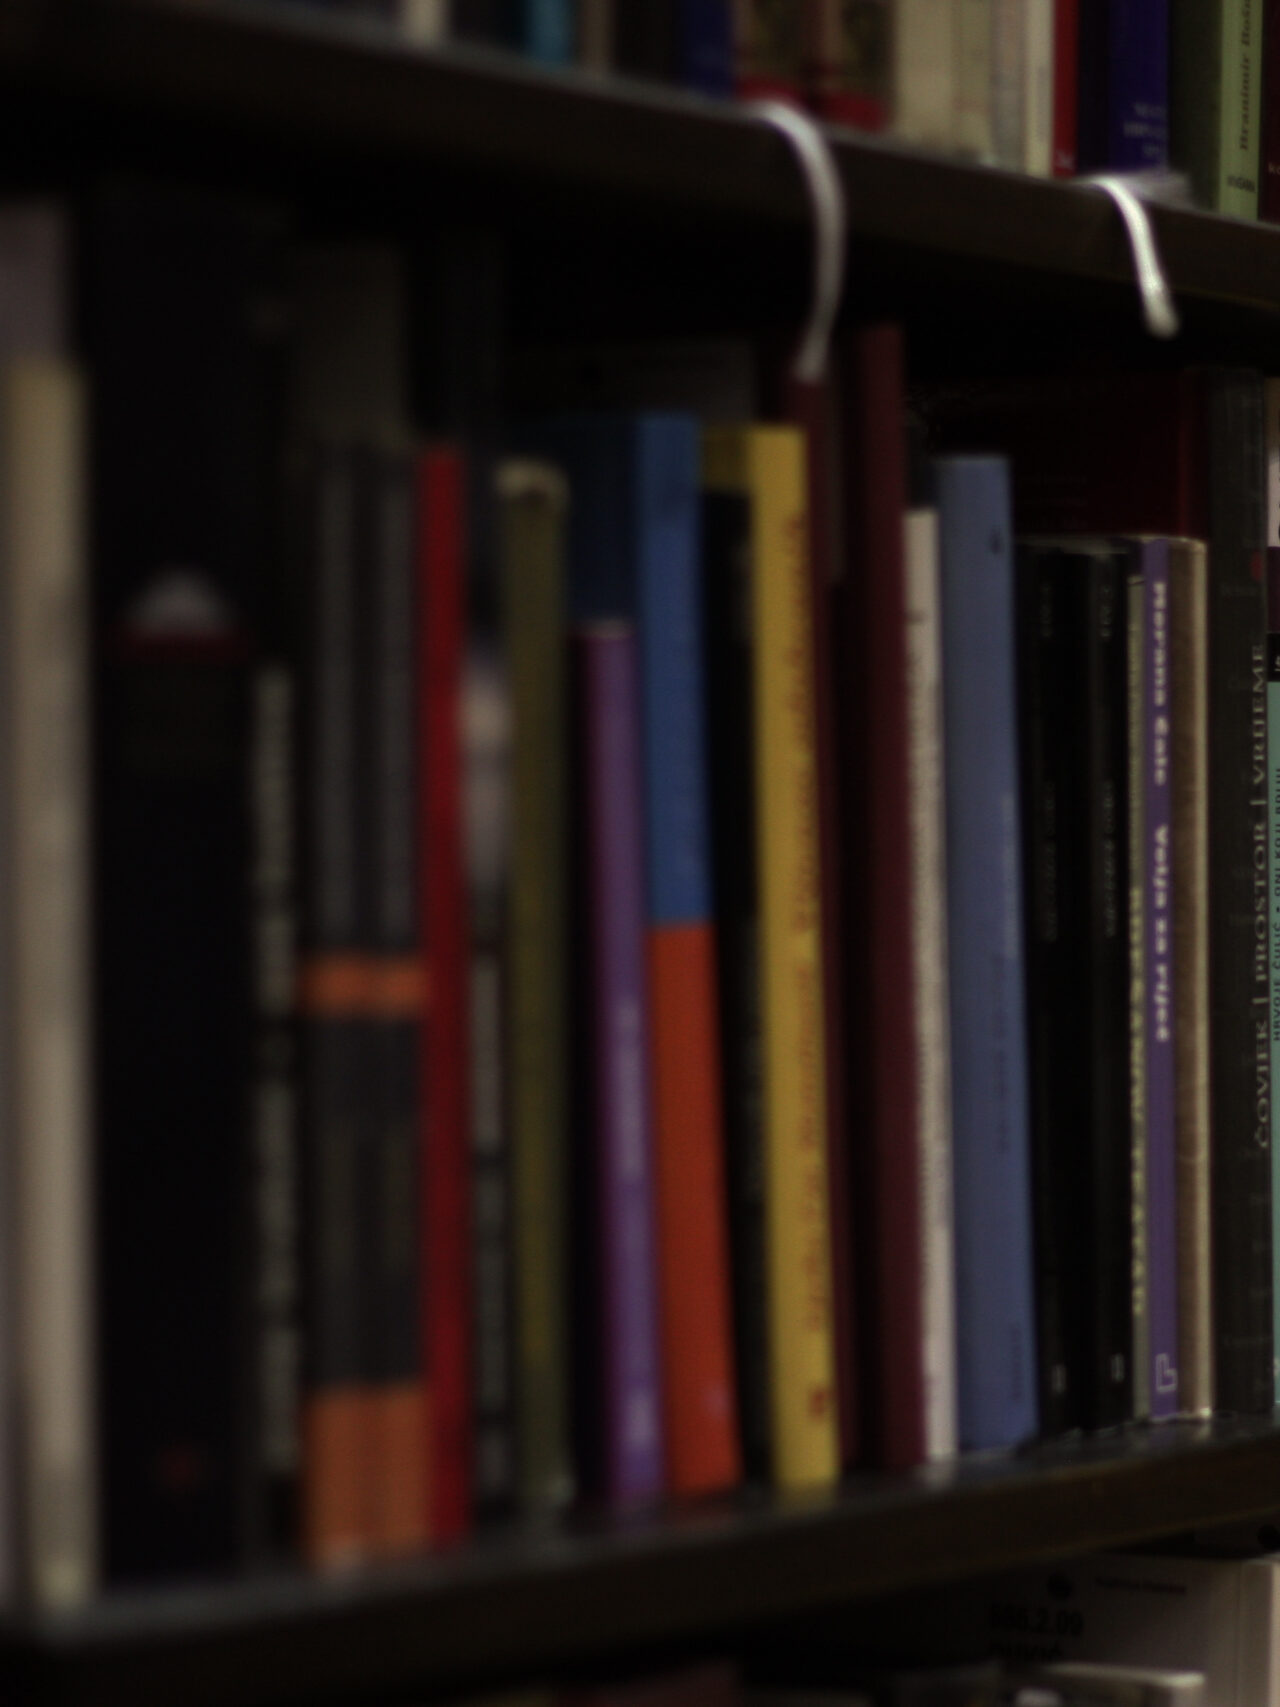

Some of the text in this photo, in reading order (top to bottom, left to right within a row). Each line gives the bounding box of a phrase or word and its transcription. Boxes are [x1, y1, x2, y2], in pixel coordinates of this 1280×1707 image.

[1252, 644, 1270, 1150] ČOVJEK PROSTOR VRIJEME
